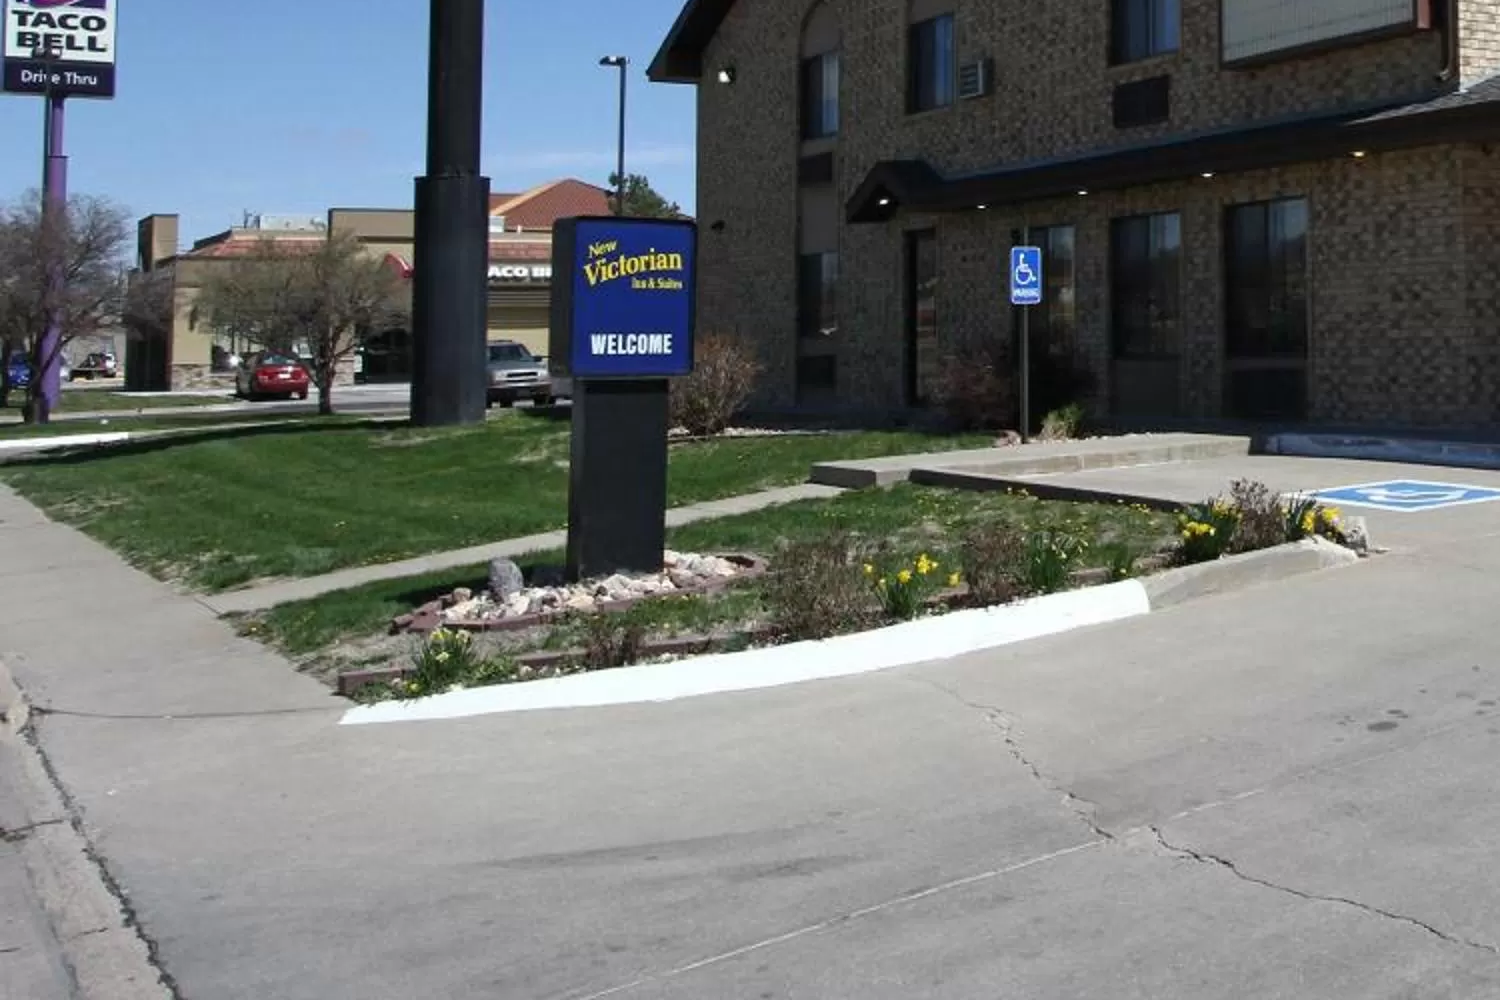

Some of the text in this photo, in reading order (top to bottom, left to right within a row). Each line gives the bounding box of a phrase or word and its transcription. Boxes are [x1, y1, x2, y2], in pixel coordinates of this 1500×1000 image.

[11, 10, 107, 32] TACO
[16, 31, 108, 53] BELL
[64, 71, 98, 86] Thru
[588, 240, 618, 259] New
[487, 265, 529, 278] ACO
[584, 247, 683, 287] Victorian
[590, 332, 673, 356] WELCOME
